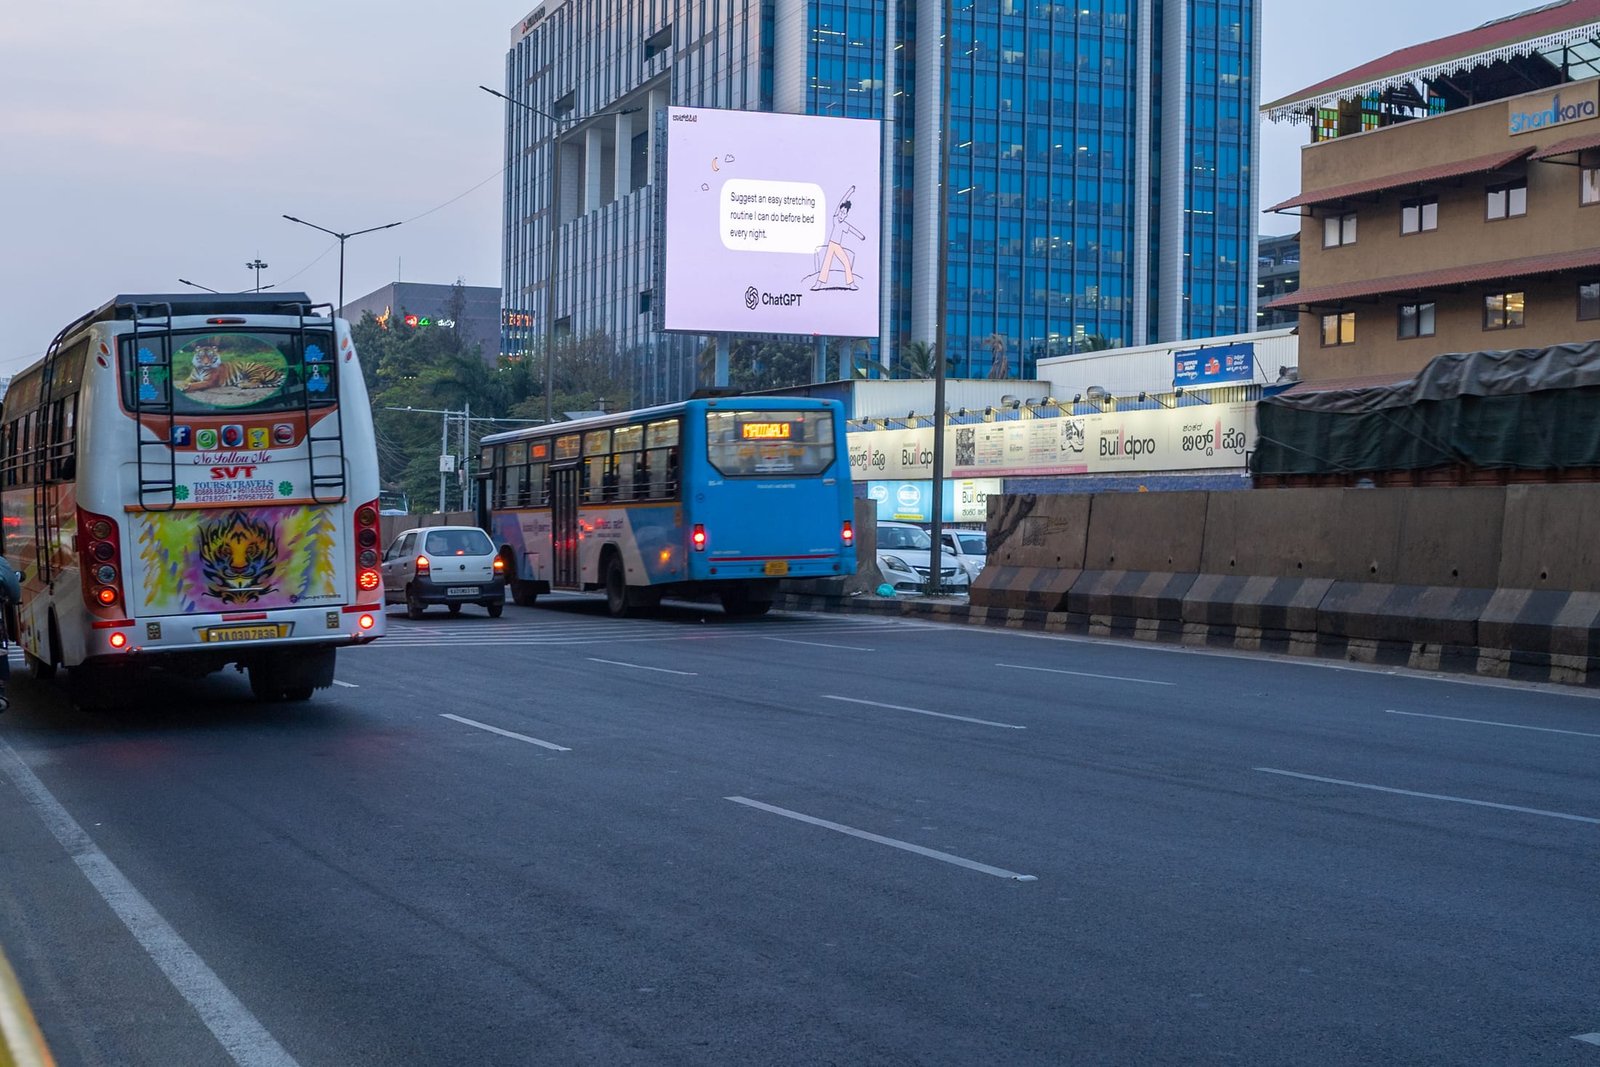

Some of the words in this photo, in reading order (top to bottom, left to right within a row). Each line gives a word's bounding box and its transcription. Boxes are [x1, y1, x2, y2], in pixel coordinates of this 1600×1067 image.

[1508, 94, 1595, 132] shankara
[730, 191, 757, 205] Suggest
[758, 195, 767, 204] an
[767, 196, 782, 206] easy
[783, 196, 816, 209] stretching
[730, 210, 753, 220] routine
[757, 213, 769, 221] can
[770, 212, 779, 221] do
[780, 212, 801, 223] before
[801, 213, 815, 224] bed
[730, 229, 748, 240] every
[748, 228, 767, 241] night.
[761, 292, 803, 307] ChatGPT
[1100, 427, 1156, 460] Buildpro
[193, 451, 212, 465] No
[251, 449, 273, 463] Me
[902, 442, 934, 469] Buildp
[210, 464, 257, 480] SVT
[962, 489, 987, 506] Buildp
